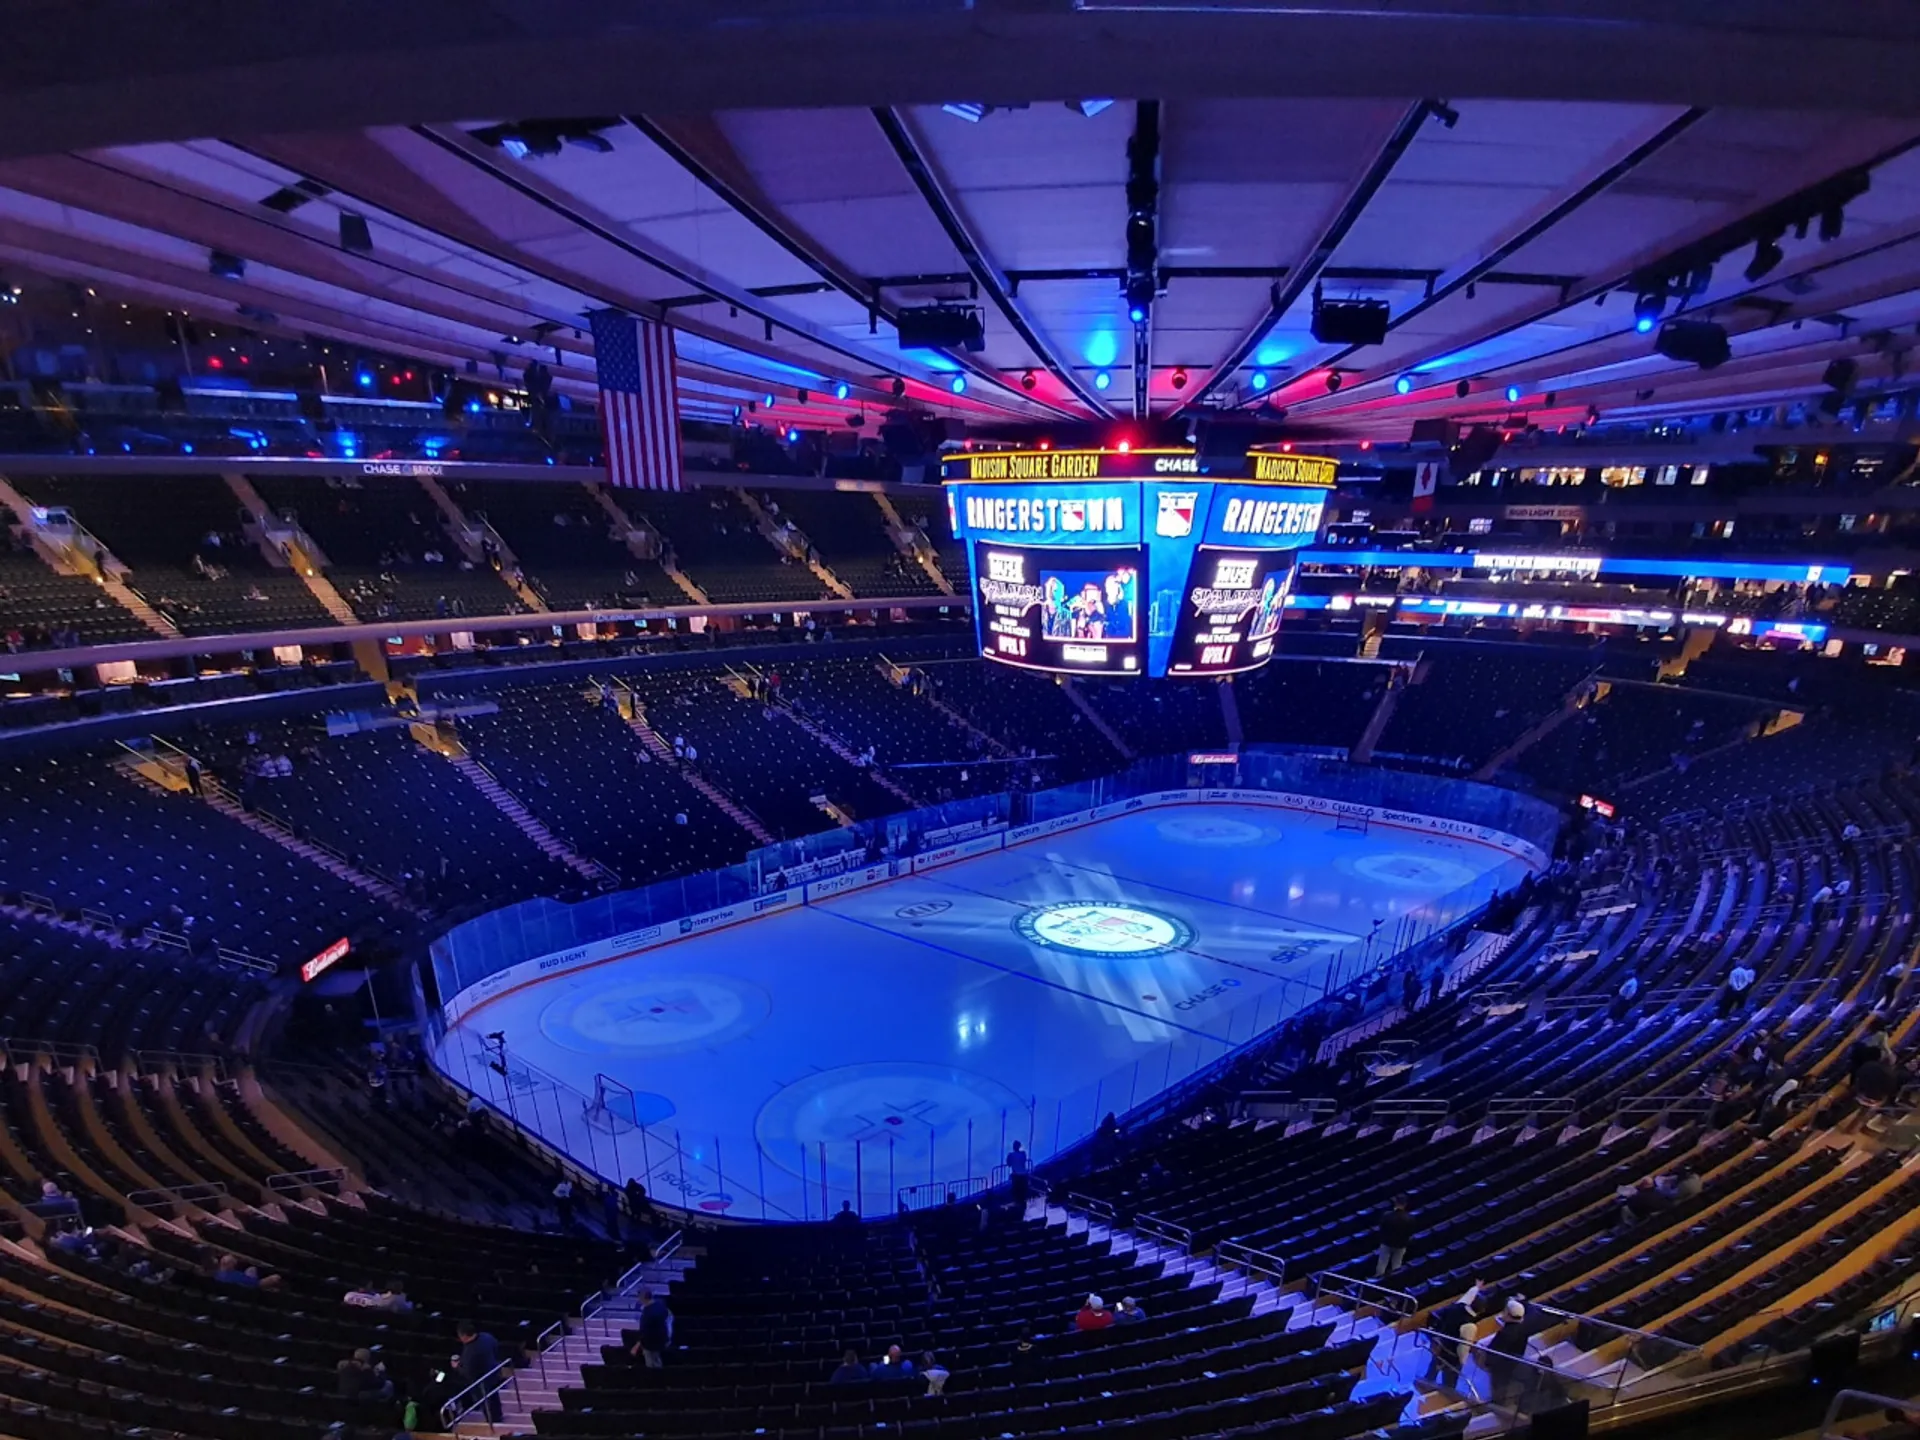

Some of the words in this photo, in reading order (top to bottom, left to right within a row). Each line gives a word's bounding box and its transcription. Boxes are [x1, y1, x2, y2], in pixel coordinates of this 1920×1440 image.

[363, 464, 401, 474] CHASE
[971, 456, 1007, 478] MADISON
[1009, 455, 1048, 478] SQUARE
[1051, 454, 1099, 477] GARDEN
[1155, 458, 1198, 473] CHASE
[1256, 456, 1296, 480] MADISON
[1441, 822, 1473, 833] DELTA
[540, 957, 559, 969] BUD
[1174, 984, 1227, 1011] CHASE
